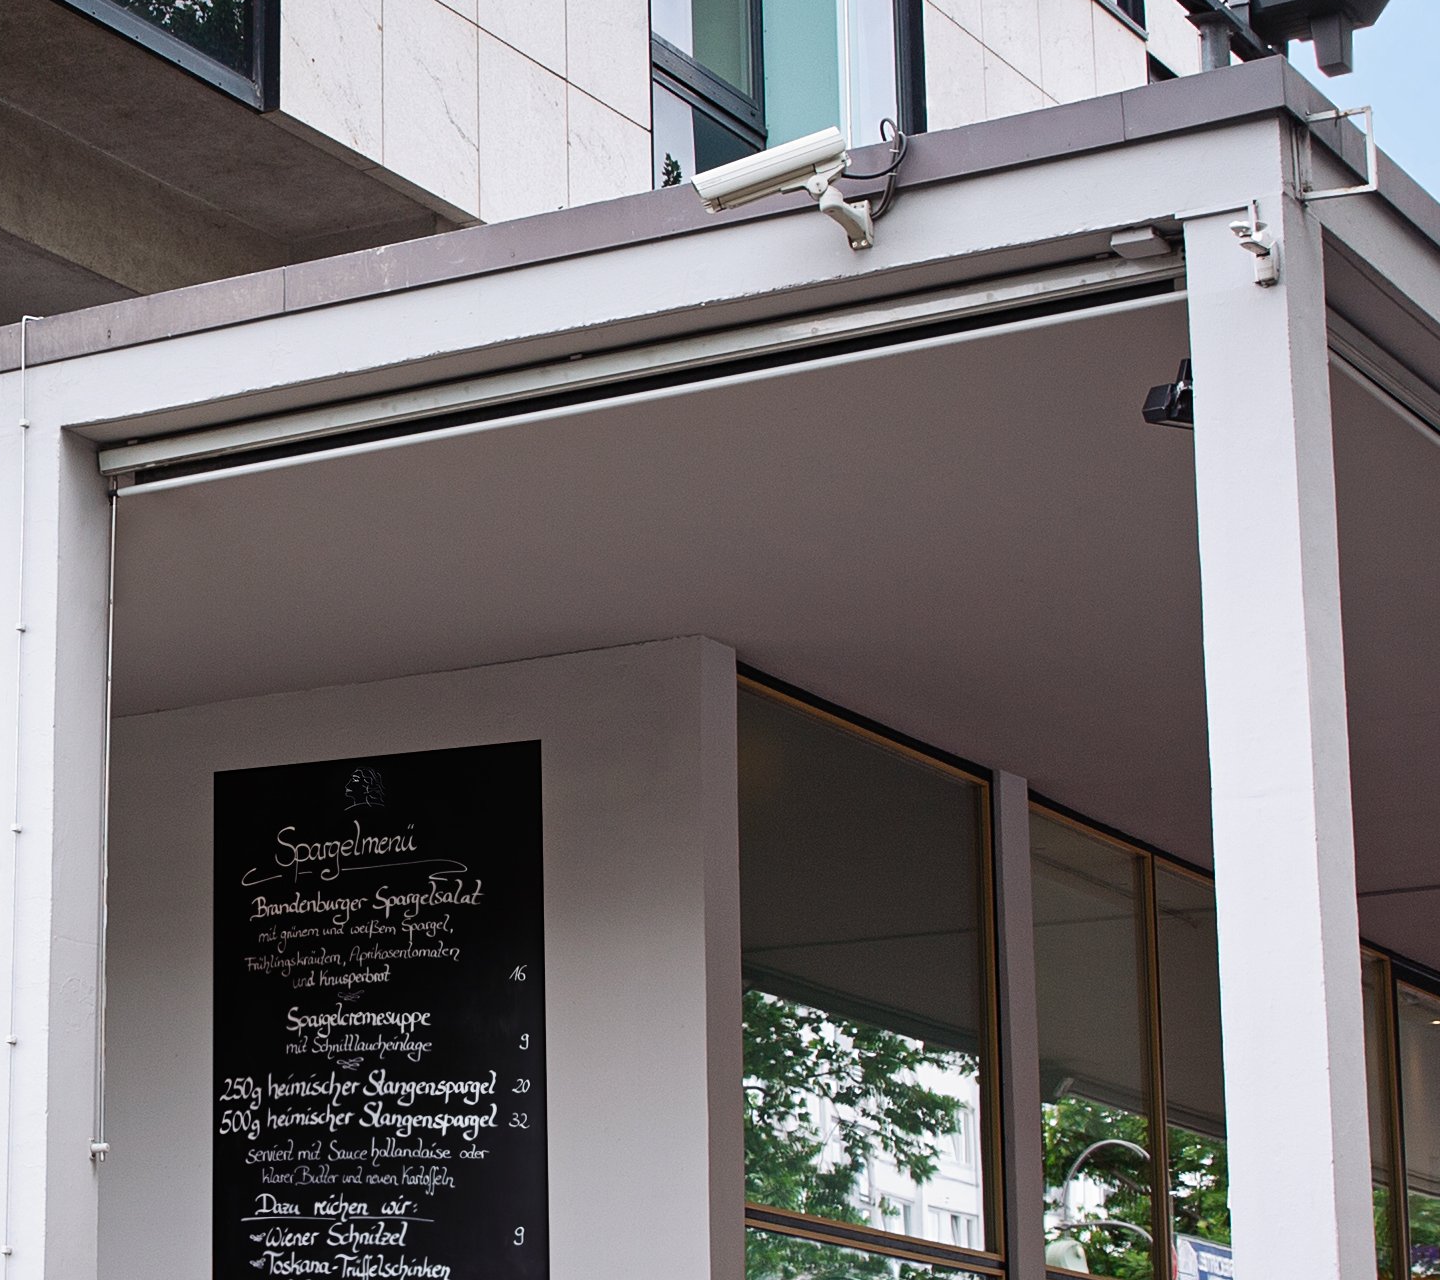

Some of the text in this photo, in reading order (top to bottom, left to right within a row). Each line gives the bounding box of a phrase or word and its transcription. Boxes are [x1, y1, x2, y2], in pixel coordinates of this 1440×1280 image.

[275, 820, 417, 882] Spargelmenü
[250, 880, 484, 925] Brandenburger Spargelsalat
[258, 914, 454, 953] mit grünem und weißem Spargel,
[350, 940, 459, 966] Aprikosentomaten
[293, 964, 391, 988] und Knusperbrot
[509, 964, 526, 981] 16
[286, 1003, 431, 1038] Spargelcremesuppe
[286, 1033, 432, 1062] mit Schnittlaucheinlage
[519, 1033, 529, 1050] 9
[220, 1069, 497, 1110] 250g heimischer Stangenspargel
[512, 1078, 530, 1094] 20
[220, 1101, 498, 1141] 500g heimischer Stangenspargel
[508, 1113, 530, 1129] 32
[246, 1137, 490, 1167] serviert mit Sauce hollandaise oder
[295, 1164, 339, 1187] Butter
[342, 1167, 363, 1185] und
[366, 1173, 399, 1186] neuen
[402, 1166, 455, 1196] Kartoffeln
[254, 1193, 418, 1222] Dazu reichen wir:
[265, 1221, 408, 1252] Wiener Schnitzel
[513, 1226, 525, 1245] 9
